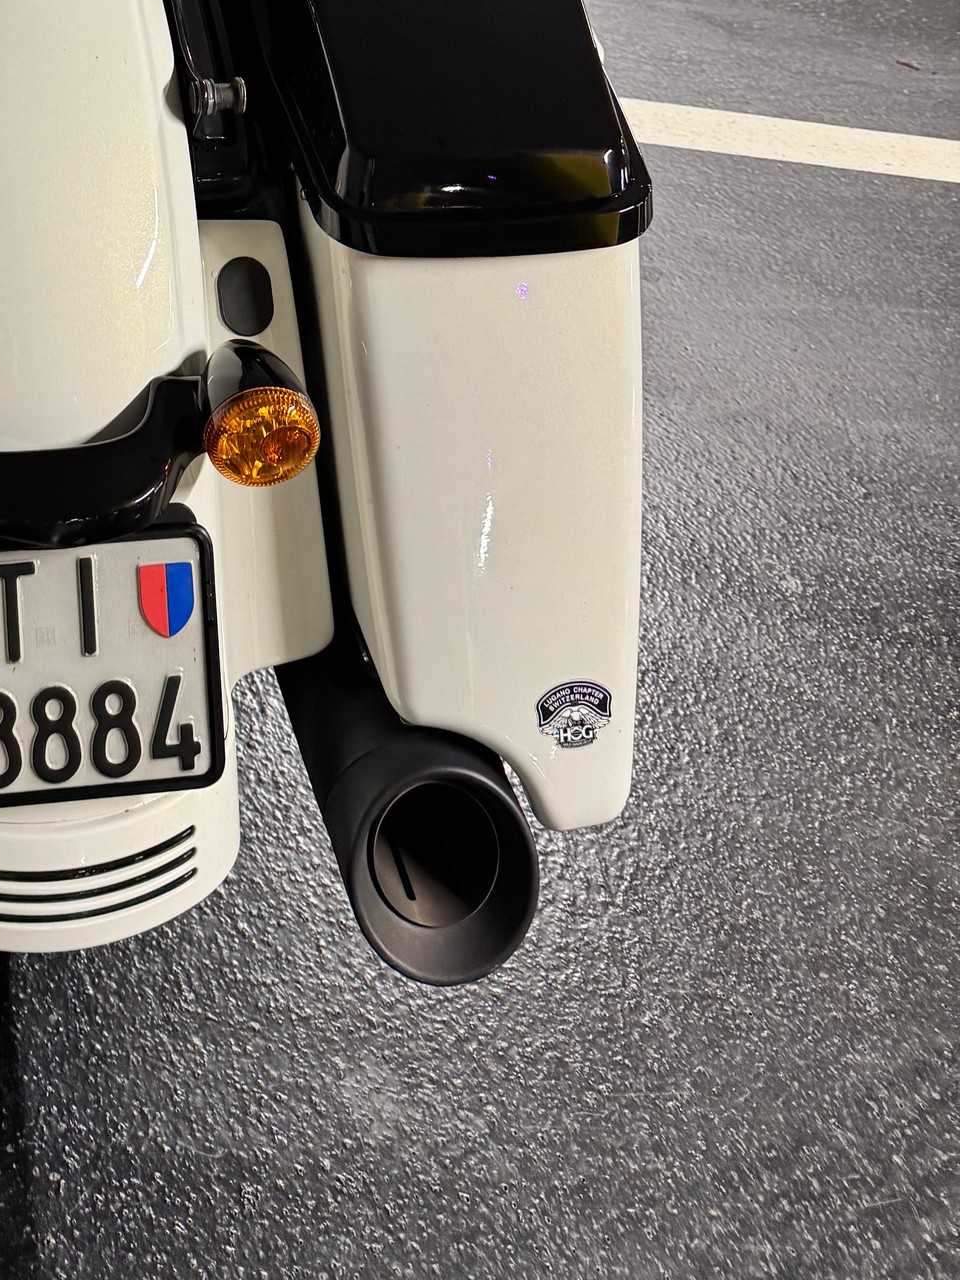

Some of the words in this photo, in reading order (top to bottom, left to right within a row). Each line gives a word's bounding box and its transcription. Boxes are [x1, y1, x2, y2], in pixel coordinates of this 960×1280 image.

[543, 688, 571, 708] LUGANO
[573, 686, 604, 700] CHAPTER
[548, 693, 600, 712] SWITZERLAND
